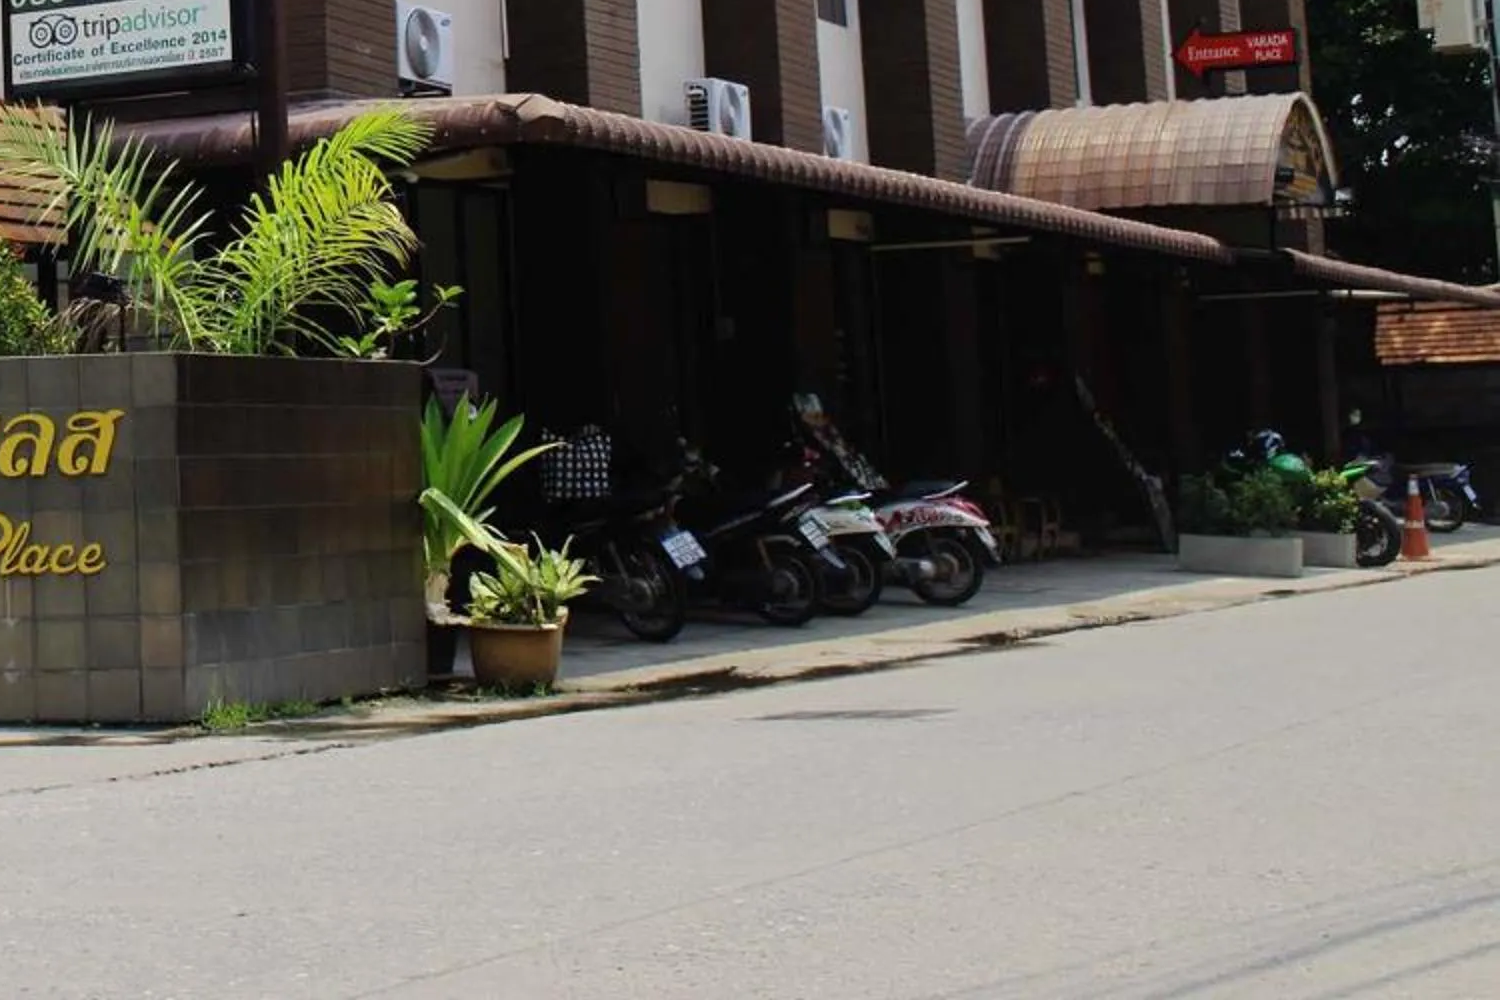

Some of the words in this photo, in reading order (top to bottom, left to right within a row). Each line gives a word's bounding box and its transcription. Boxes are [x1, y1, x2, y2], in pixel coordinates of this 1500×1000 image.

[82, 5, 201, 40] tripadvisor
[13, 45, 85, 67] Certificate
[91, 42, 104, 56] of
[111, 35, 186, 56] Excellence
[192, 28, 227, 45] 2014
[1187, 46, 1239, 60] Entrance
[1246, 34, 1288, 48] VARADA
